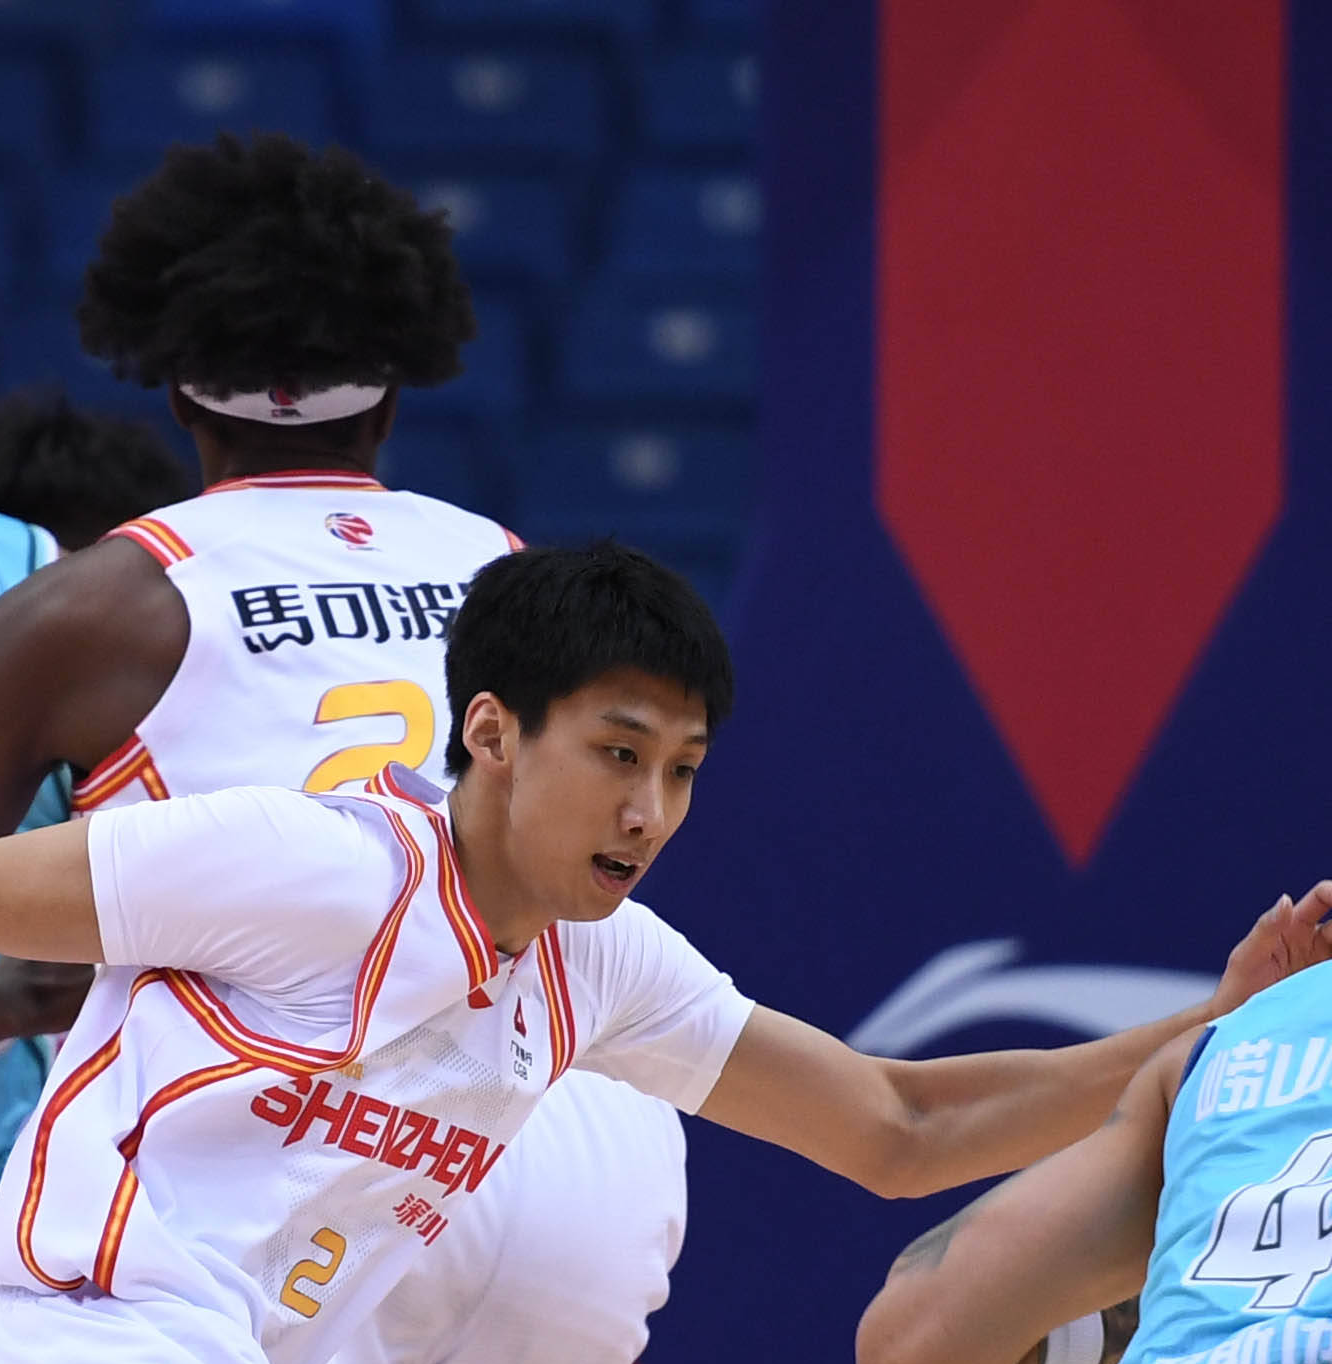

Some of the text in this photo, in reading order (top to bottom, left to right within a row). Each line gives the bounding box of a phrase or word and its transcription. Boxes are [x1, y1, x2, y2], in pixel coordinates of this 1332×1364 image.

[230, 582, 468, 655] 馬可波
[250, 1075, 506, 1200] SHENZHEN
[392, 1192, 449, 1247] 深圳
[279, 1226, 347, 1319] 2
